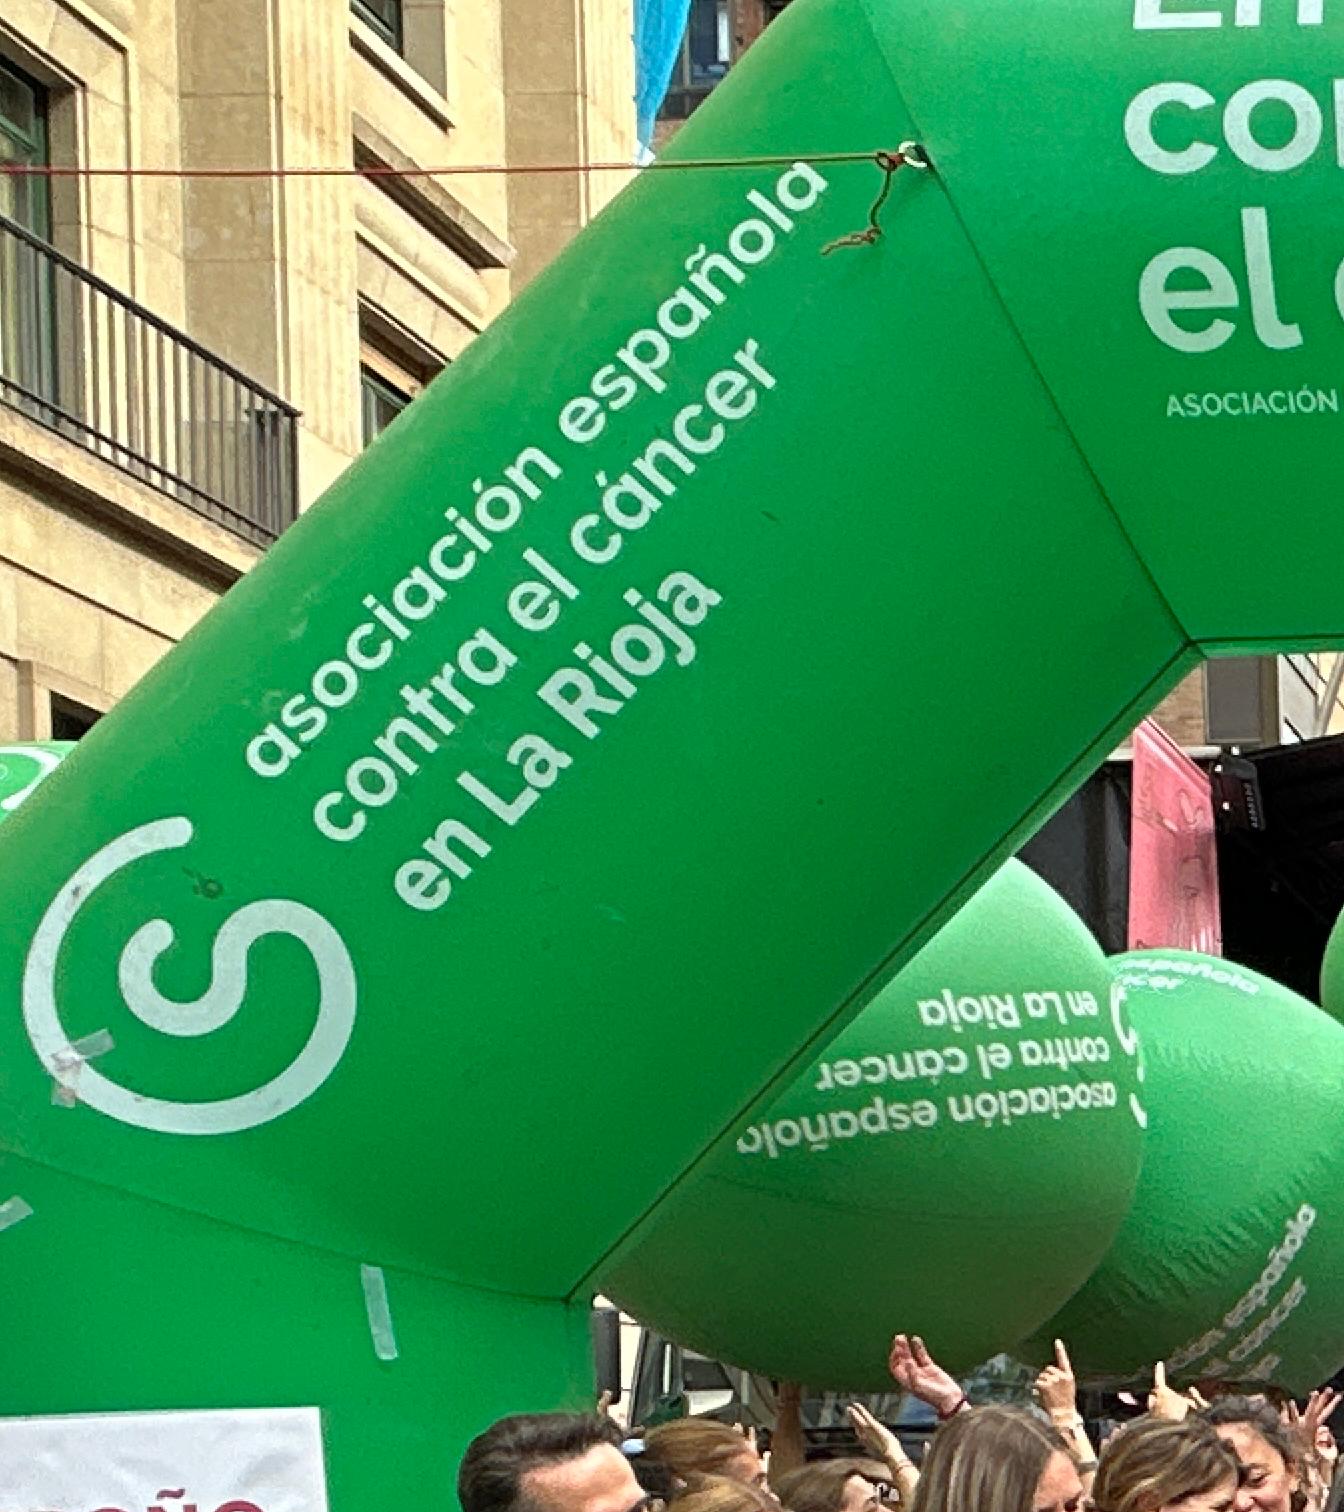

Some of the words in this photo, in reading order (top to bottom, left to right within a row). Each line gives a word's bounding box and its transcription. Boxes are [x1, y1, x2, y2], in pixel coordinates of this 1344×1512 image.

[1139, 206, 1303, 353] el
[1167, 385, 1338, 417] ASOCIACIÓN
[246, 442, 561, 779] asociación
[559, 162, 828, 445] española
[312, 626, 518, 842] contra
[507, 548, 580, 631] el
[569, 338, 777, 564] cáncer
[393, 813, 492, 911] en
[457, 724, 572, 826] La
[536, 570, 723, 740] Rioja
[918, 988, 1021, 1033] Rioja
[1024, 990, 1067, 1024] La
[1069, 989, 1099, 1016] en
[815, 1048, 968, 1091] cáncer
[979, 1042, 1012, 1078] el
[1019, 1035, 1110, 1064] contra
[948, 1081, 1117, 1127] asociación
